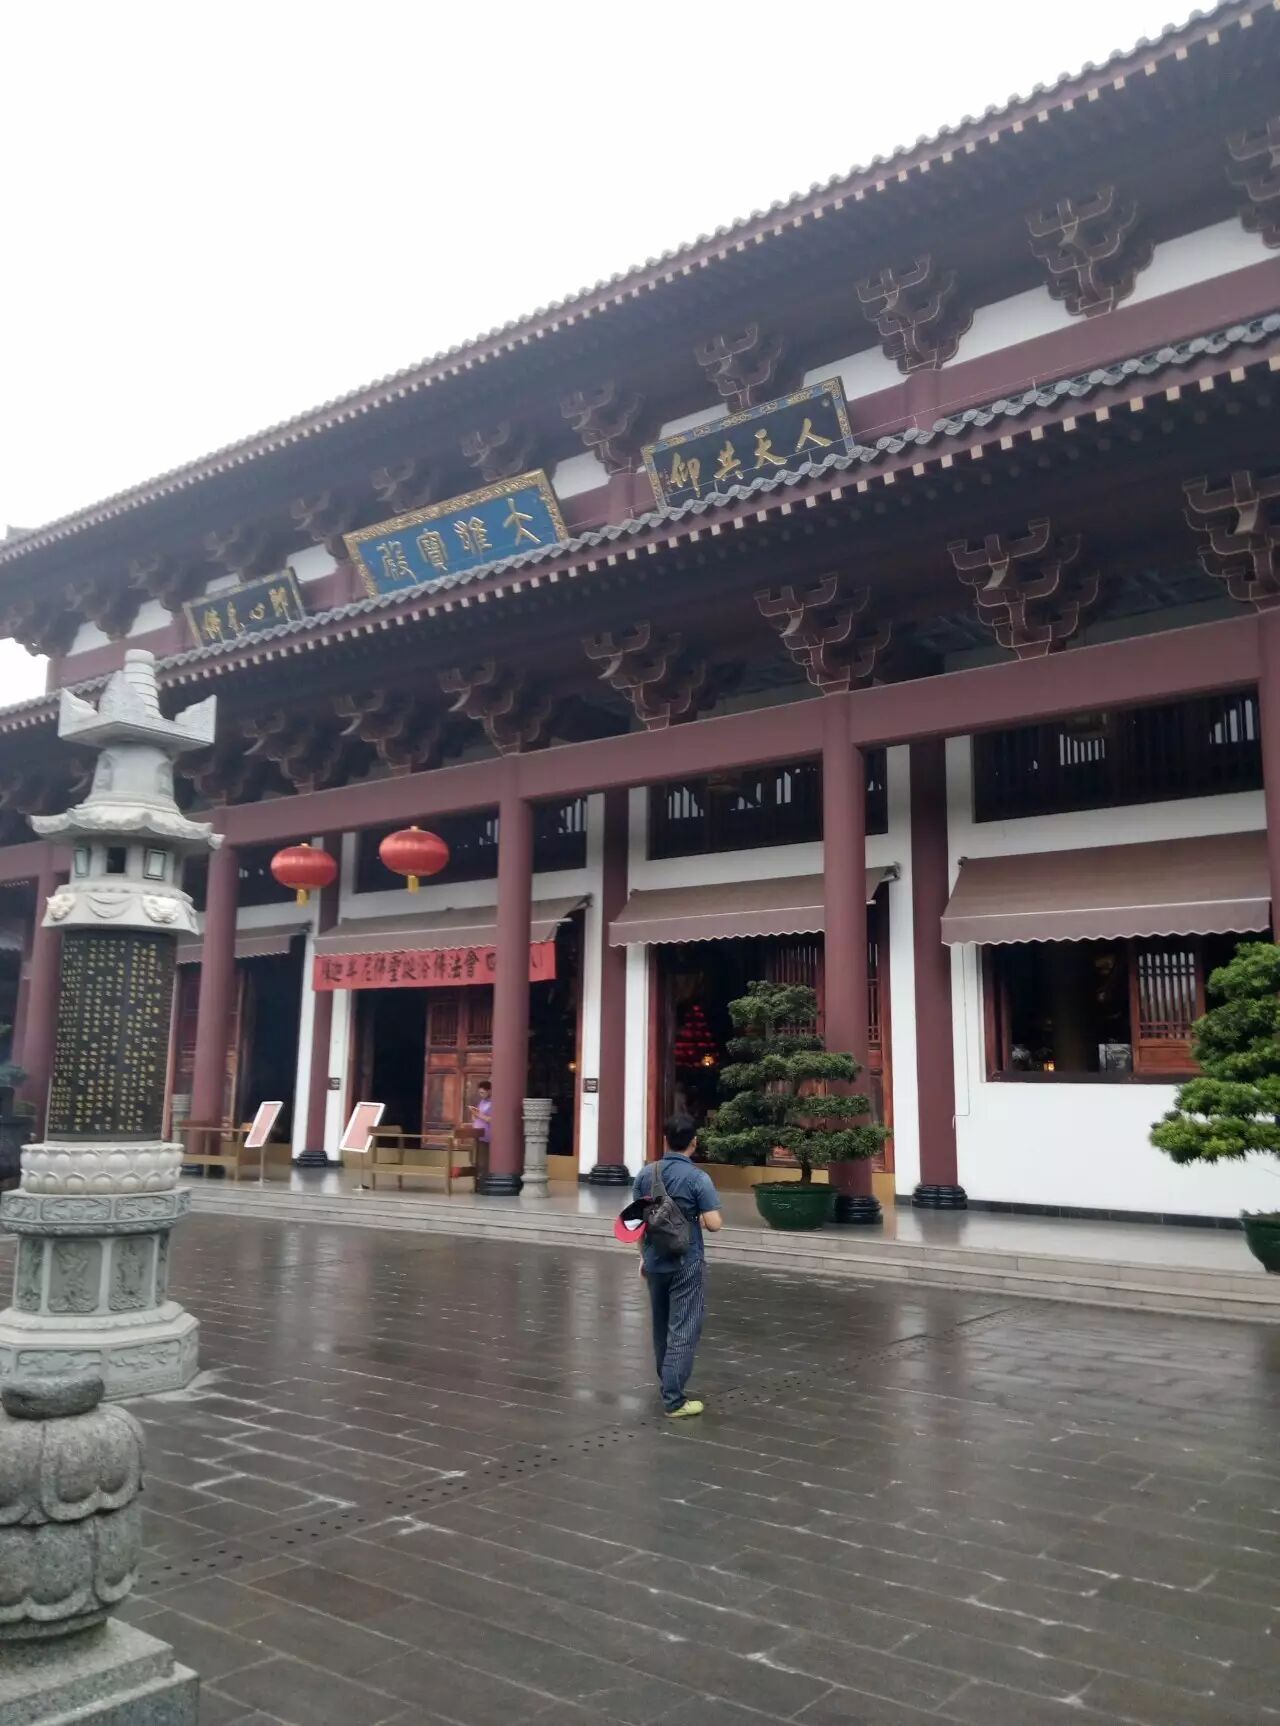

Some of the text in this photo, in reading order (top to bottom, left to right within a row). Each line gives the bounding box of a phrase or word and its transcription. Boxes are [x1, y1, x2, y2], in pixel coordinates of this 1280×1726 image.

[669, 417, 833, 498] 人天共仰
[376, 497, 541, 584] 大雄寶殿
